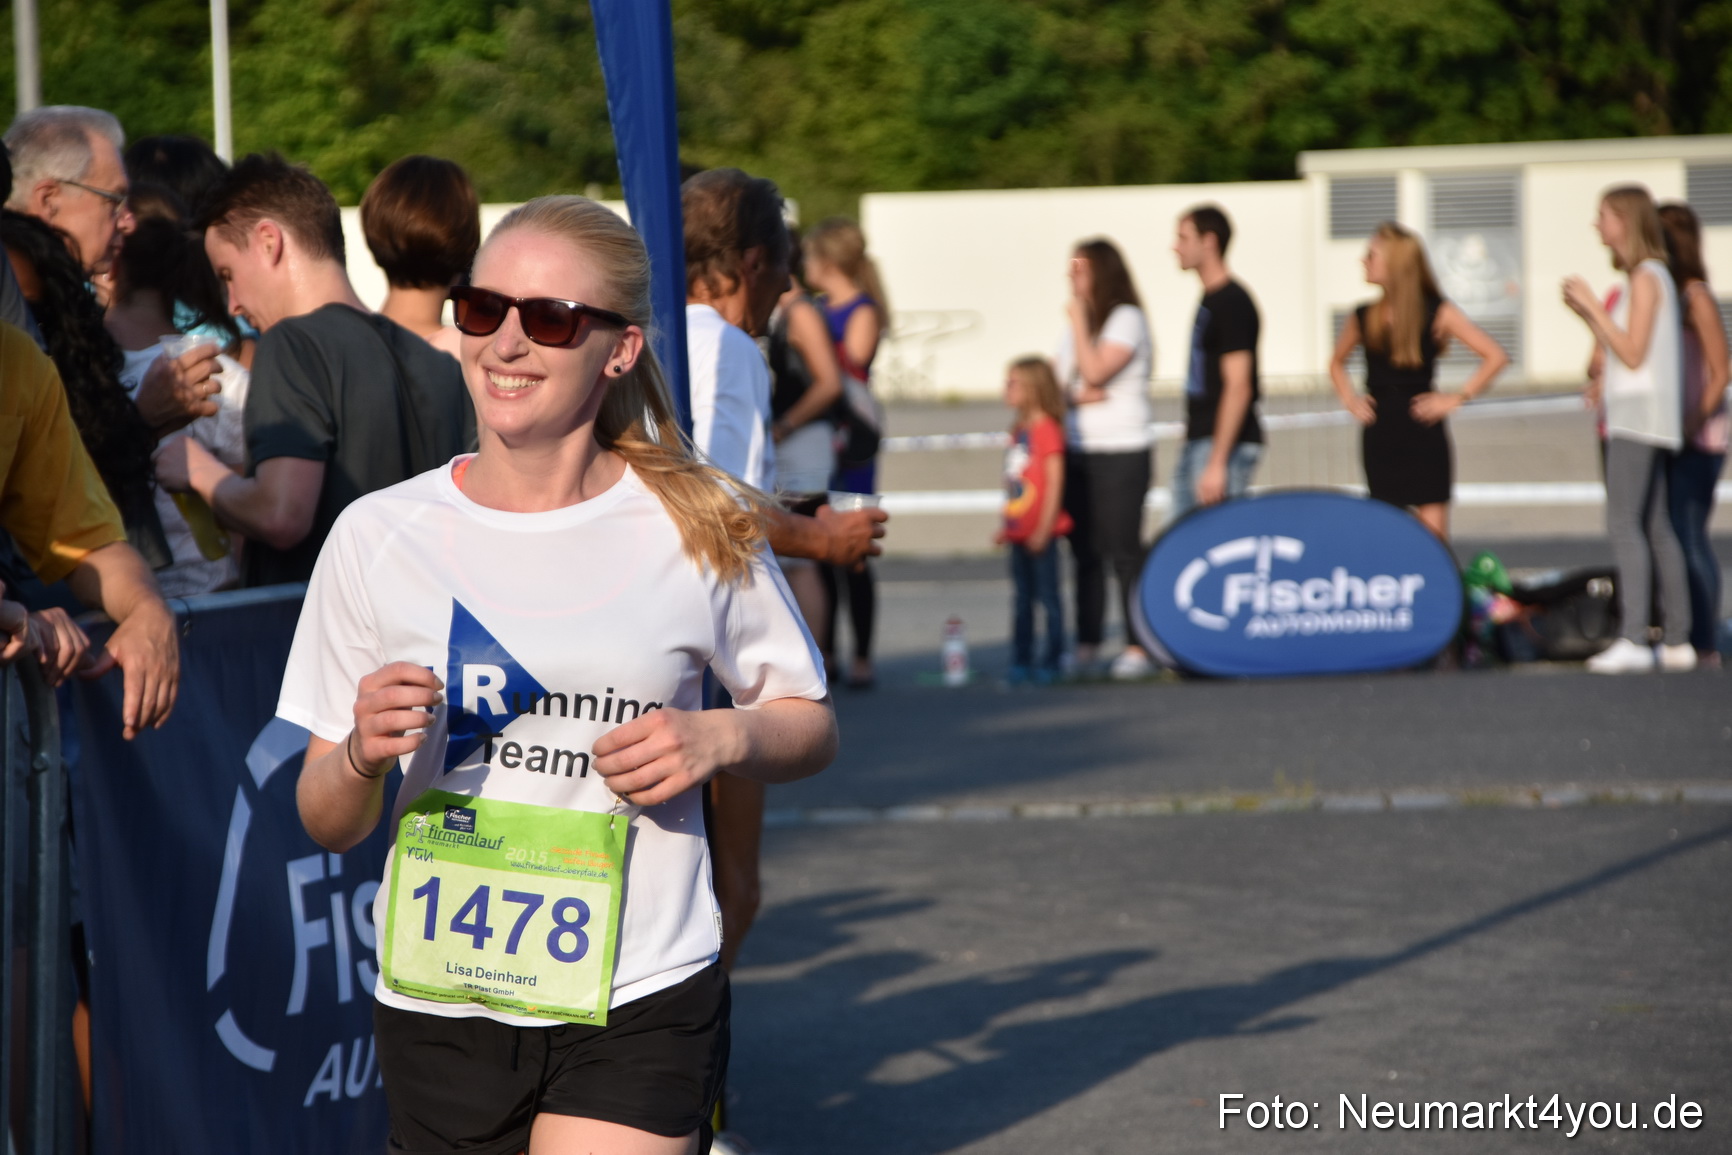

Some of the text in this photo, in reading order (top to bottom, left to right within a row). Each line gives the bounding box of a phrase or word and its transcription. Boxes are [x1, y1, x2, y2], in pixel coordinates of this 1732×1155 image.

[1222, 566, 1425, 619] Fischer
[1244, 607, 1413, 639] AUTOMOBILE
[476, 732, 590, 778] Team
[427, 840, 460, 849] neumarkt
[428, 825, 505, 850] firmenlauf
[505, 847, 548, 865] 2015
[413, 876, 590, 963] 1478
[446, 961, 537, 987] Lisa Deinhard
[473, 984, 491, 993] Plast
[493, 986, 515, 996] GmbH
